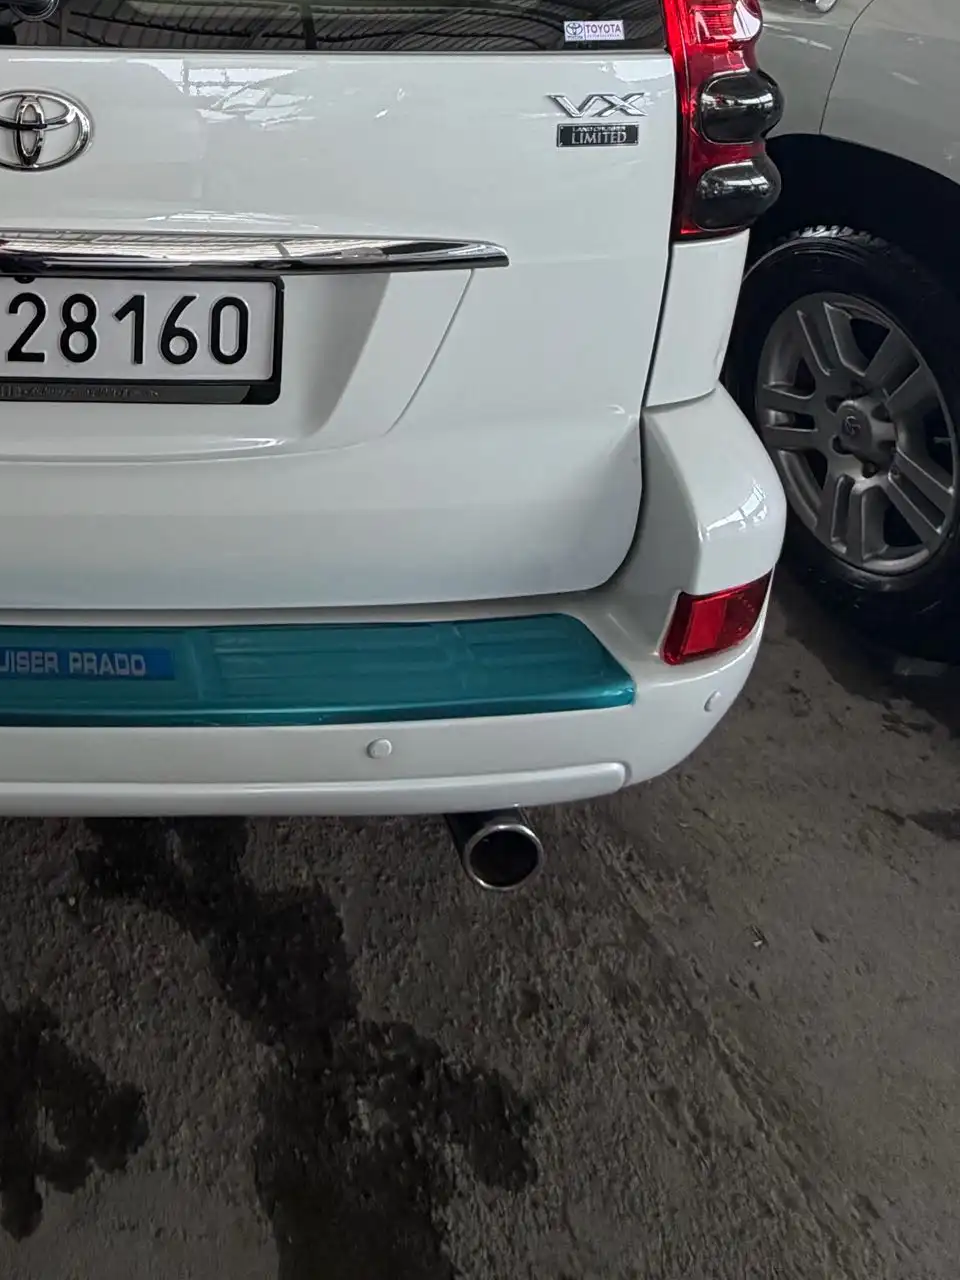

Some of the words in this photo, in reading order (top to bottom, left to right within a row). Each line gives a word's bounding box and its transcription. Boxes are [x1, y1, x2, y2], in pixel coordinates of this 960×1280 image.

[585, 23, 622, 34] TOYOTA
[545, 92, 648, 118] VX
[571, 131, 627, 144] LIMITED
[6, 292, 249, 365] 28160
[69, 651, 147, 677] PRADO
